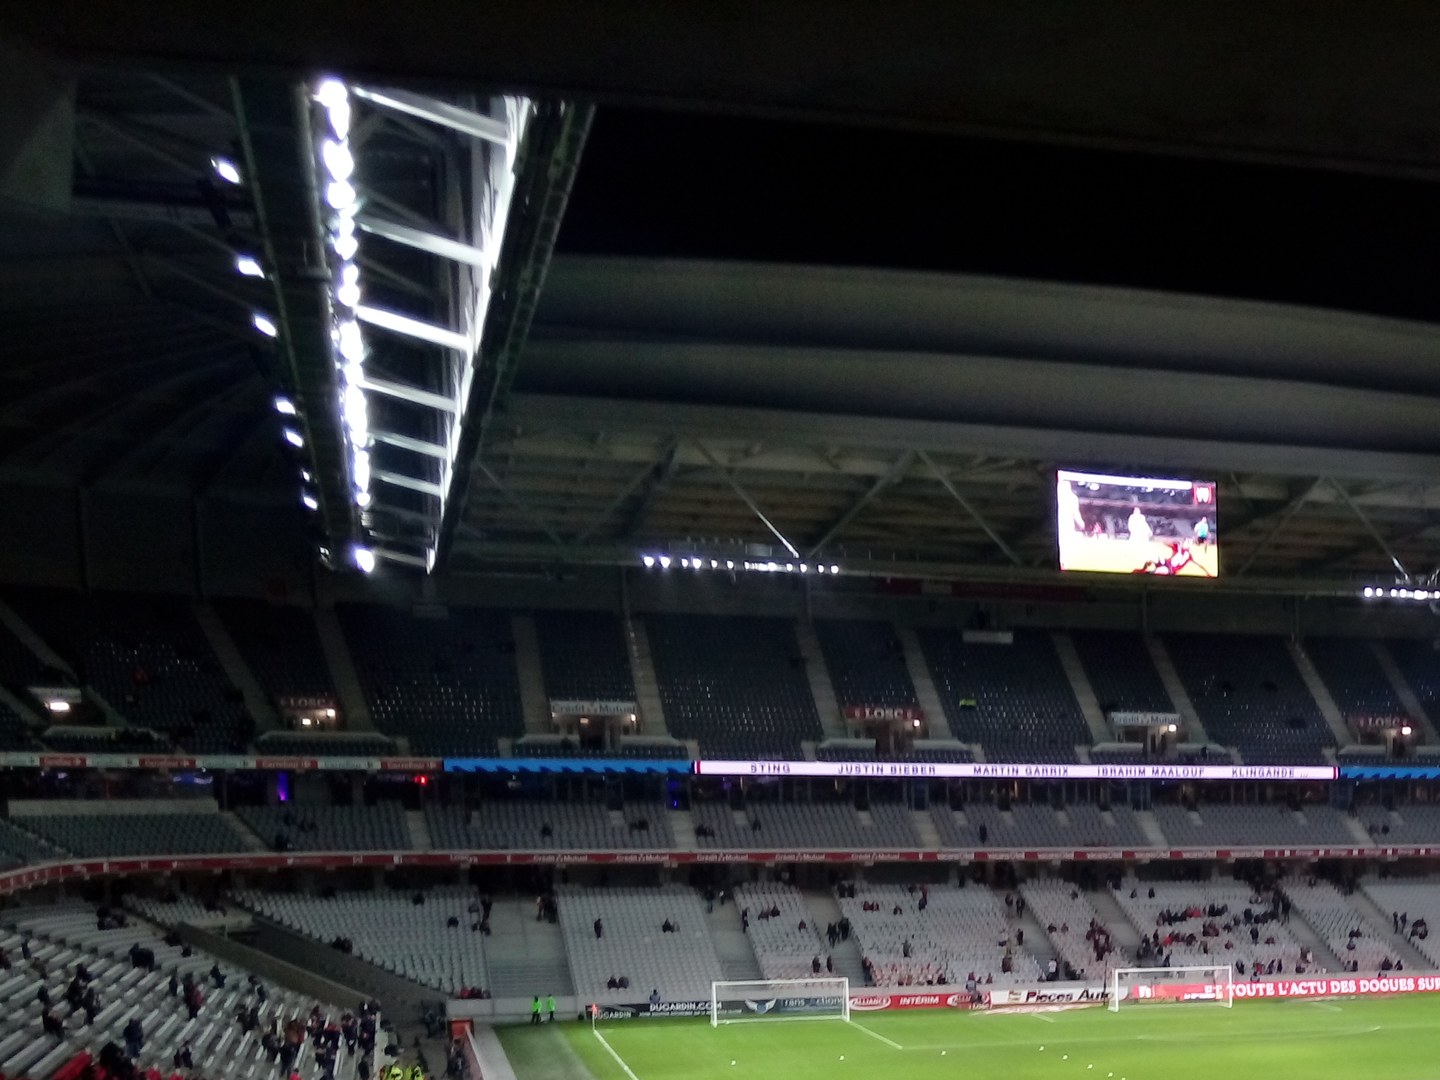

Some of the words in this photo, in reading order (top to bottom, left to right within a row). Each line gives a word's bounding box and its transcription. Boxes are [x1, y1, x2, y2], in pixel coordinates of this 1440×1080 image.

[750, 763, 790, 774] STING
[838, 764, 887, 775] JUSTIN
[889, 765, 936, 776] BIEBER
[973, 766, 1019, 776] MARTIN
[1097, 767, 1146, 777] IBRAHIM
[1151, 768, 1205, 778] MAALOUF
[1231, 769, 1295, 778] KLINGANDE
[1278, 981, 1326, 996] L'ACTU
[1330, 979, 1357, 994] DES
[1360, 977, 1415, 993] DOGUES
